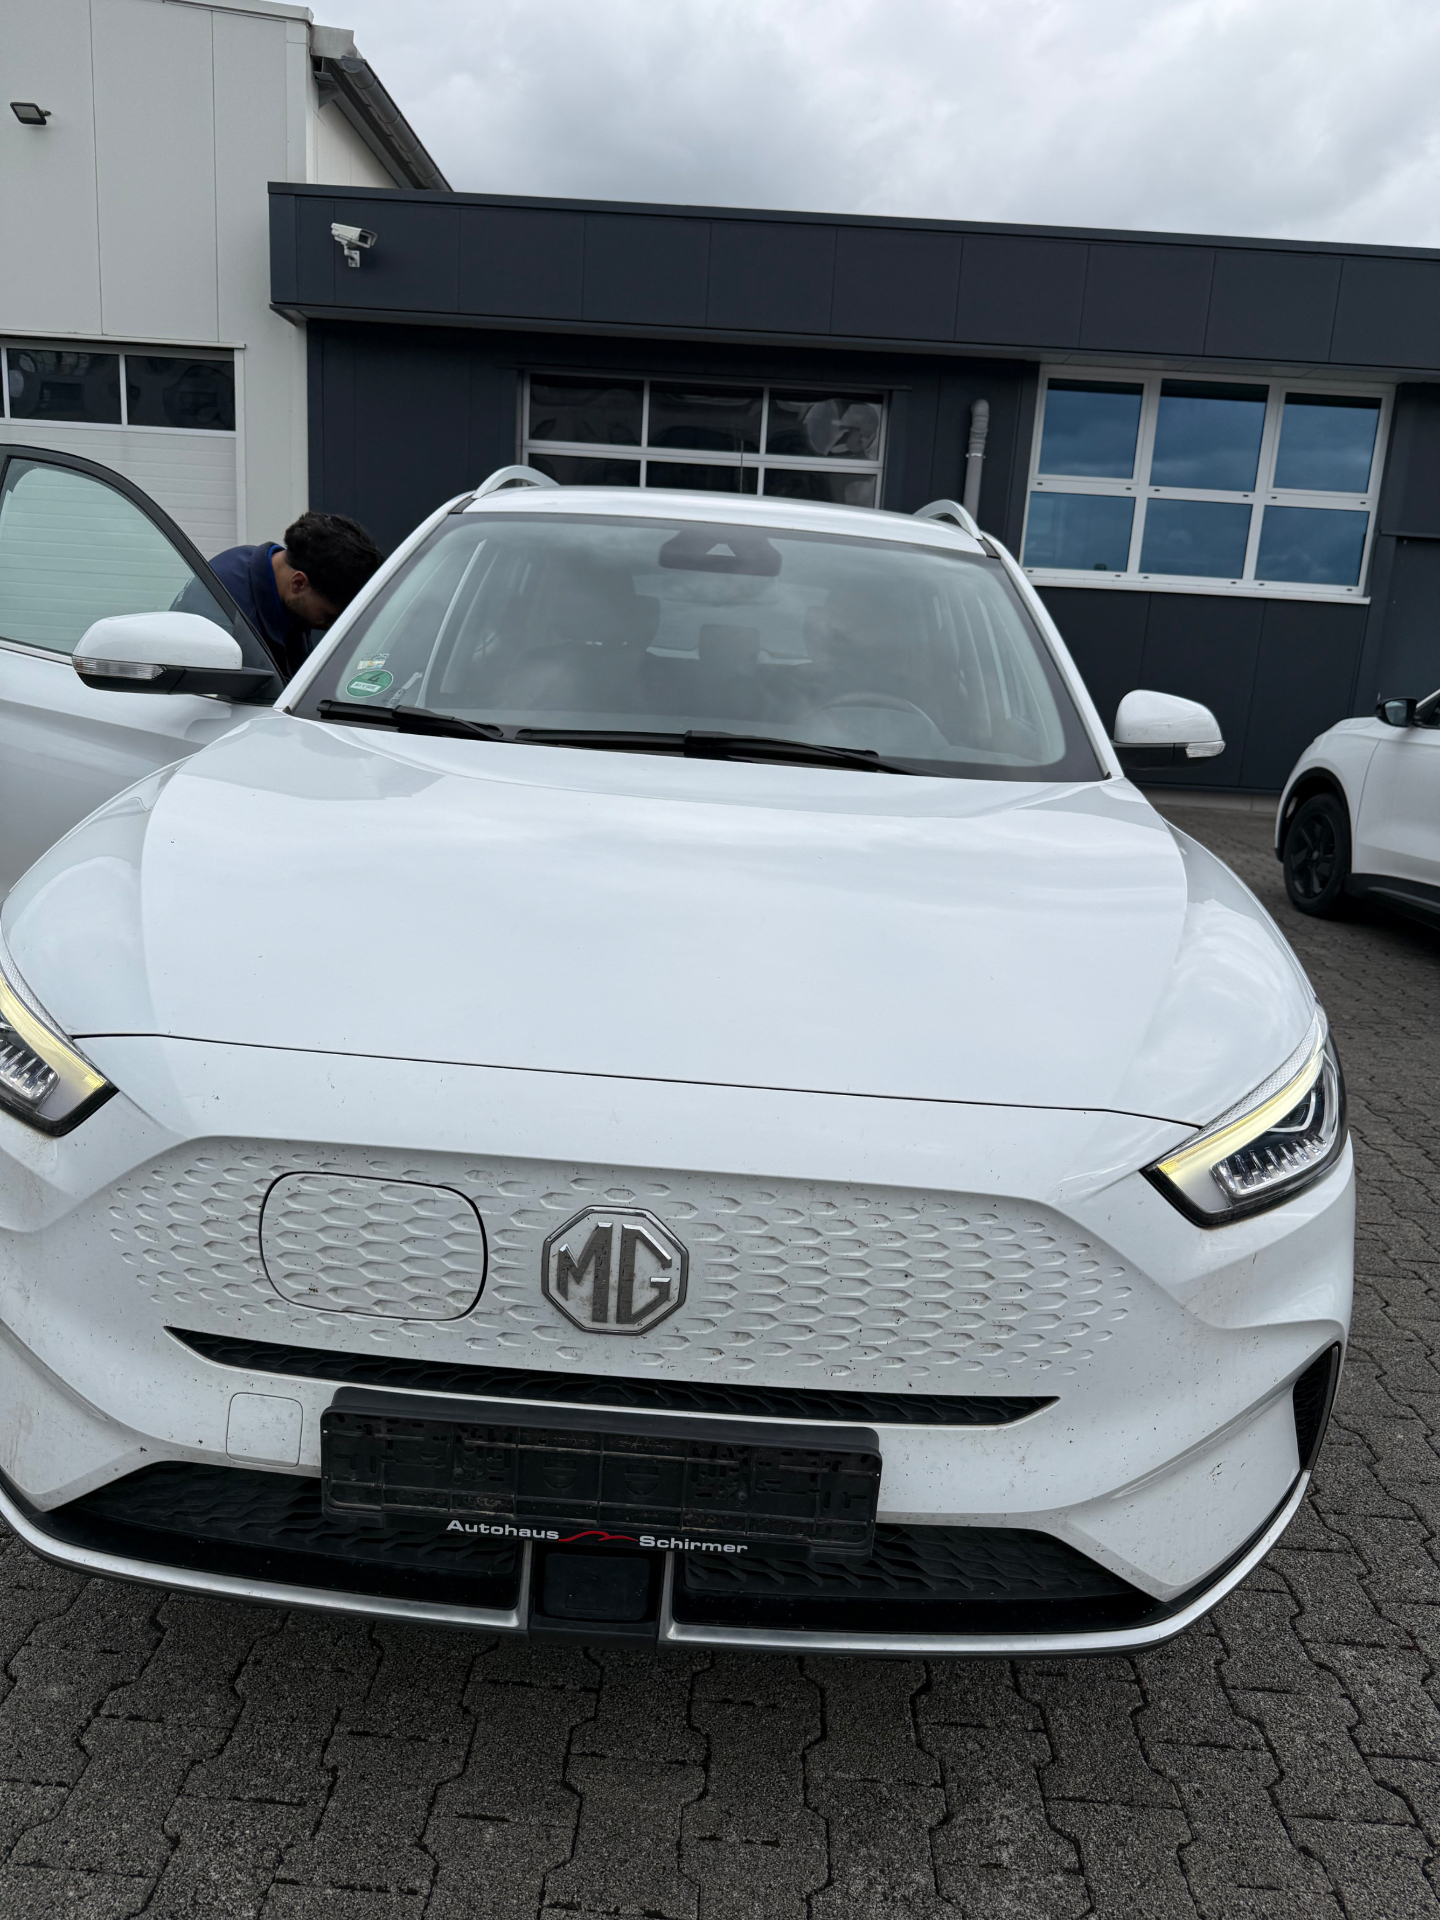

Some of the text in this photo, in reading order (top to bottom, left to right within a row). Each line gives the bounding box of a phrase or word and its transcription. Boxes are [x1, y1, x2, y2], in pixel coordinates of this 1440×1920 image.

[367, 672, 384, 684] 4
[557, 1222, 672, 1324] MG
[446, 1519, 748, 1553] Autohaus Schirmer
